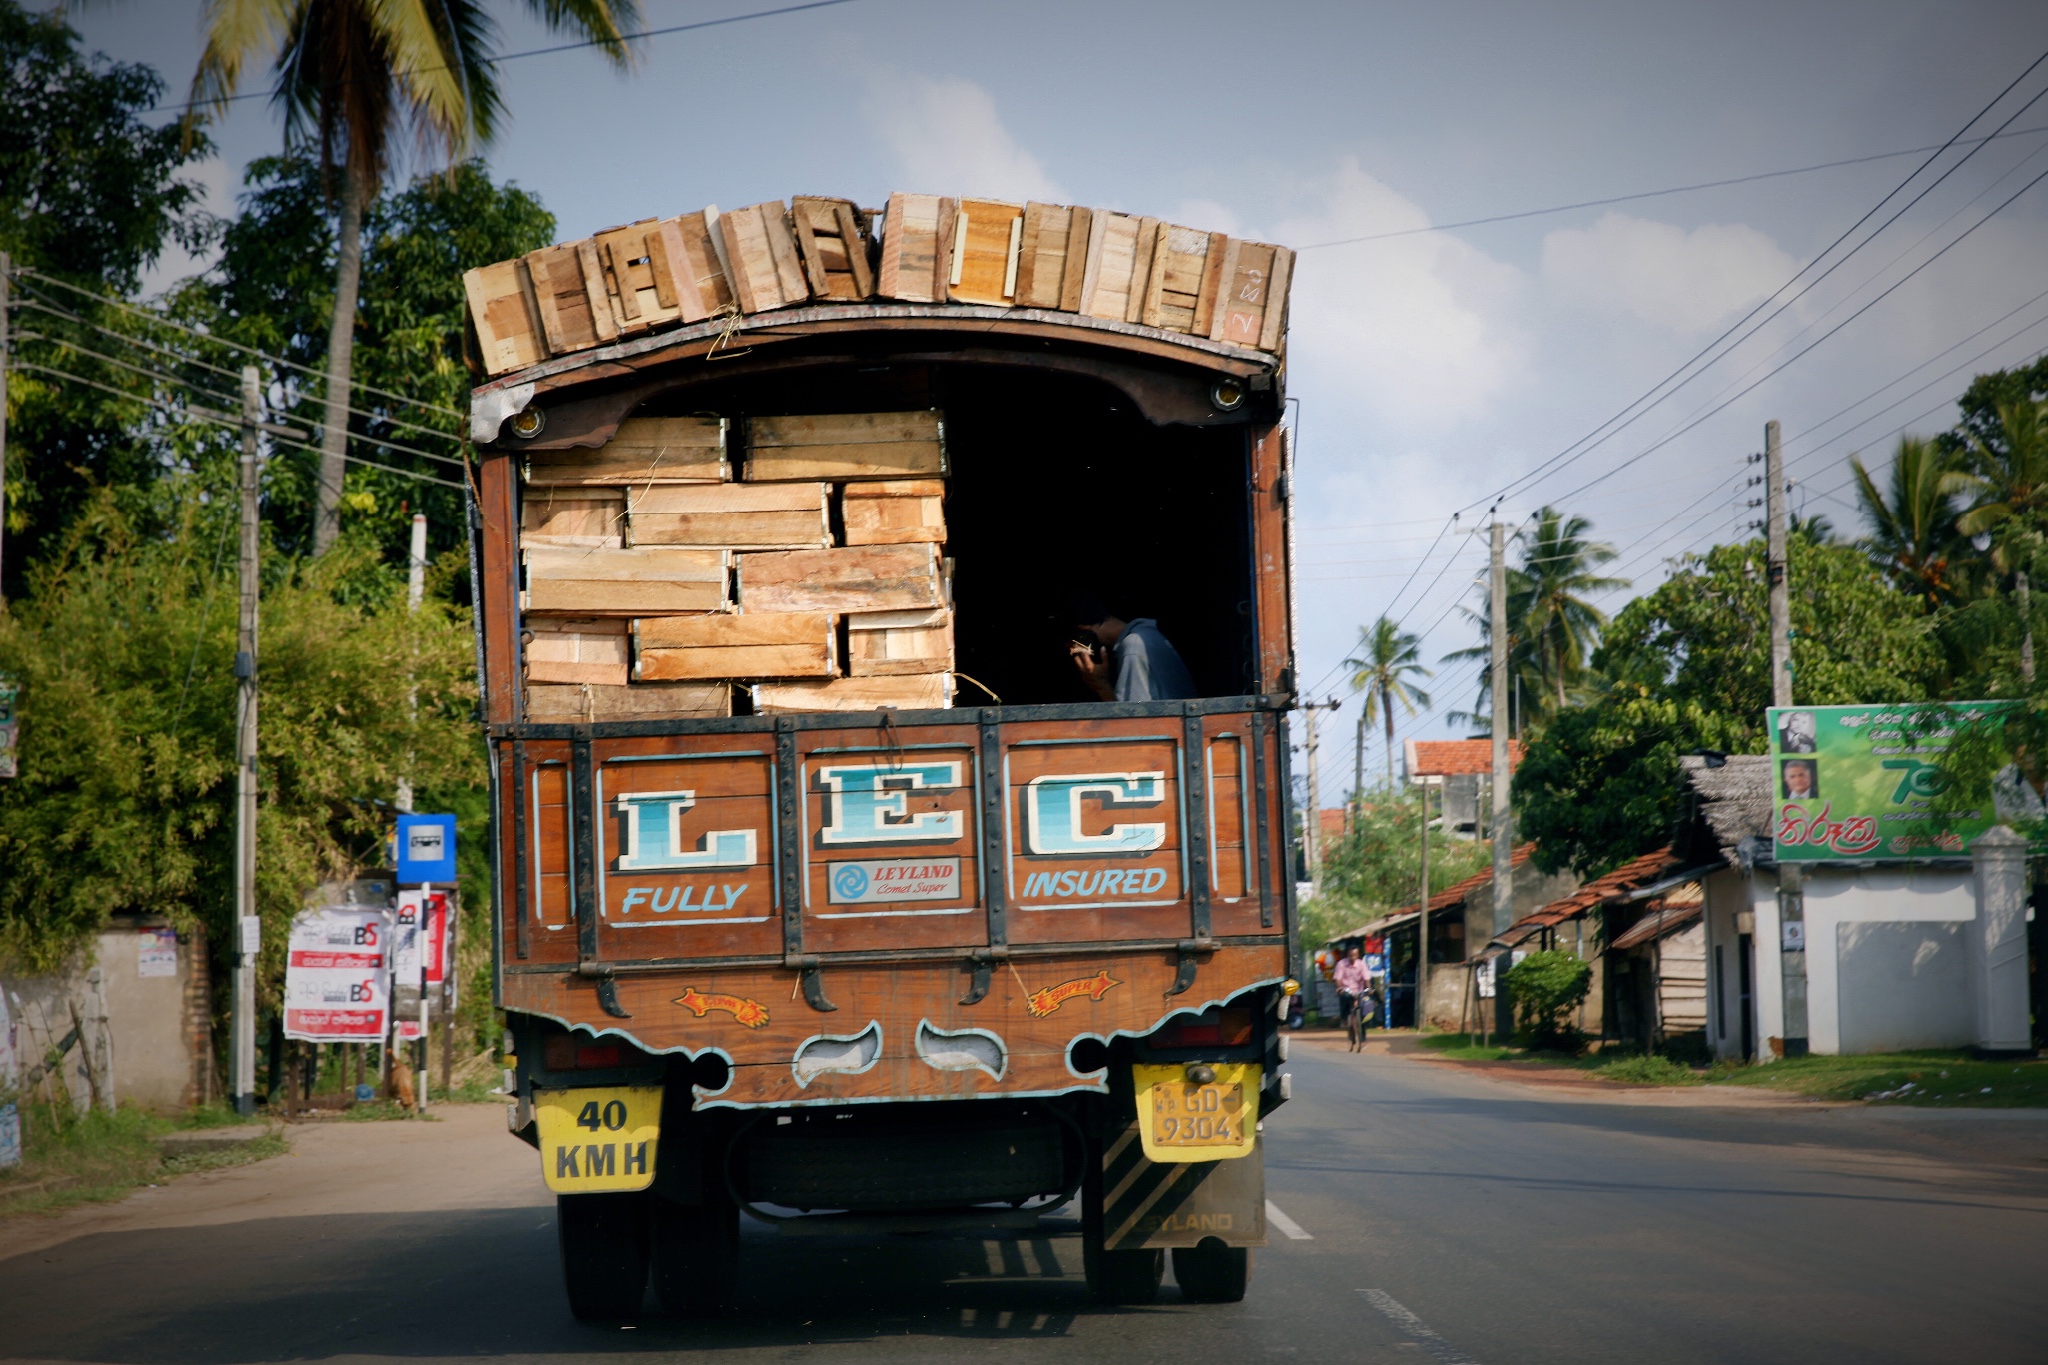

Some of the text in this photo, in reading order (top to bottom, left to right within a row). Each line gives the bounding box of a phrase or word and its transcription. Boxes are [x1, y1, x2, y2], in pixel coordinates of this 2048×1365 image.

[873, 864, 954, 881] LEYLAND
[1022, 867, 1168, 898] INSURED
[621, 883, 749, 915] FULLY
[876, 881, 948, 896] Comet Super
[1051, 981, 1093, 1002] SUPER
[576, 1099, 628, 1132] 40
[1164, 1116, 1232, 1141] 9304
[556, 1140, 647, 1179] KMH
